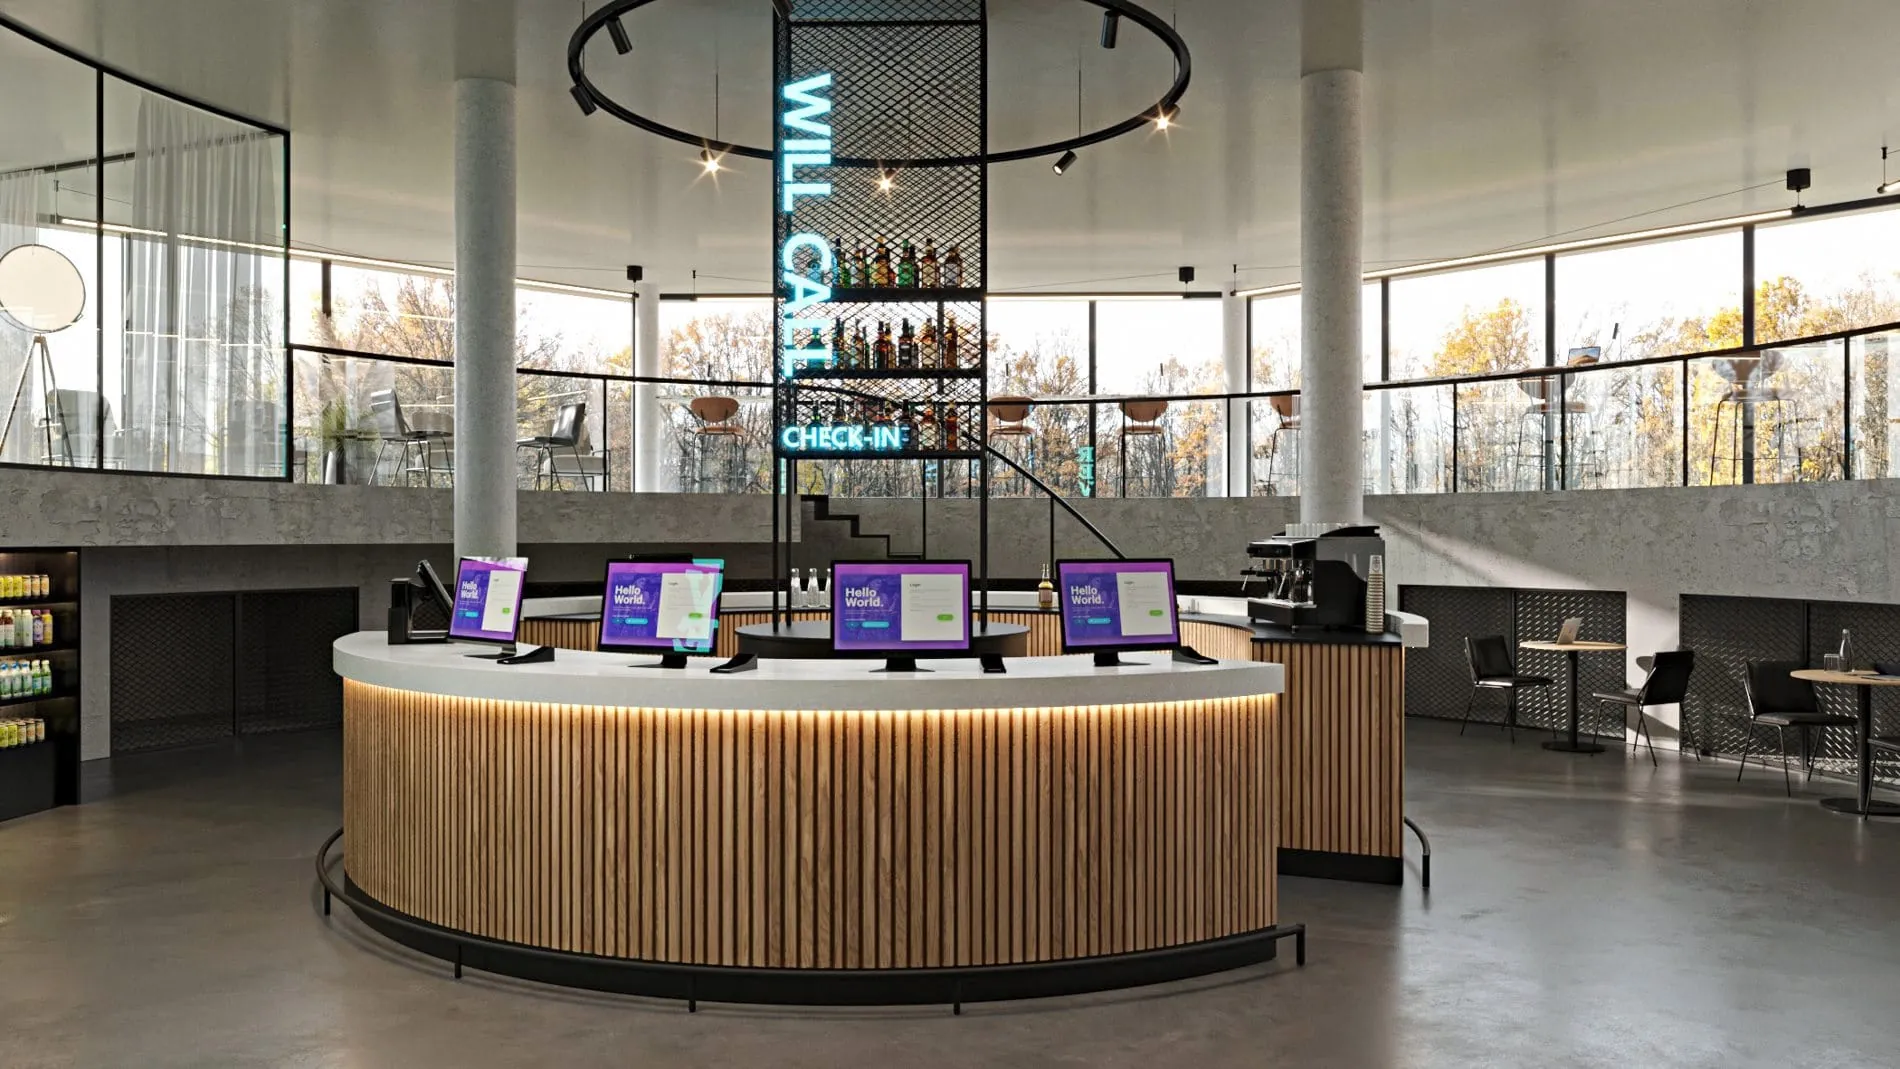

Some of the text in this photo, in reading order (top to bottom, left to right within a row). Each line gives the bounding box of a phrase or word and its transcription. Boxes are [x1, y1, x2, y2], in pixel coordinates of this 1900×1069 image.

[782, 73, 832, 377] WILL CALL
[782, 426, 901, 449] CHECK-IN
[461, 580, 478, 590] Hello
[615, 585, 641, 596] Hello
[1070, 585, 1098, 596] Hello
[845, 587, 877, 598] Hello
[614, 594, 646, 605] World.
[845, 597, 884, 608] World.
[1071, 594, 1105, 605] World.
